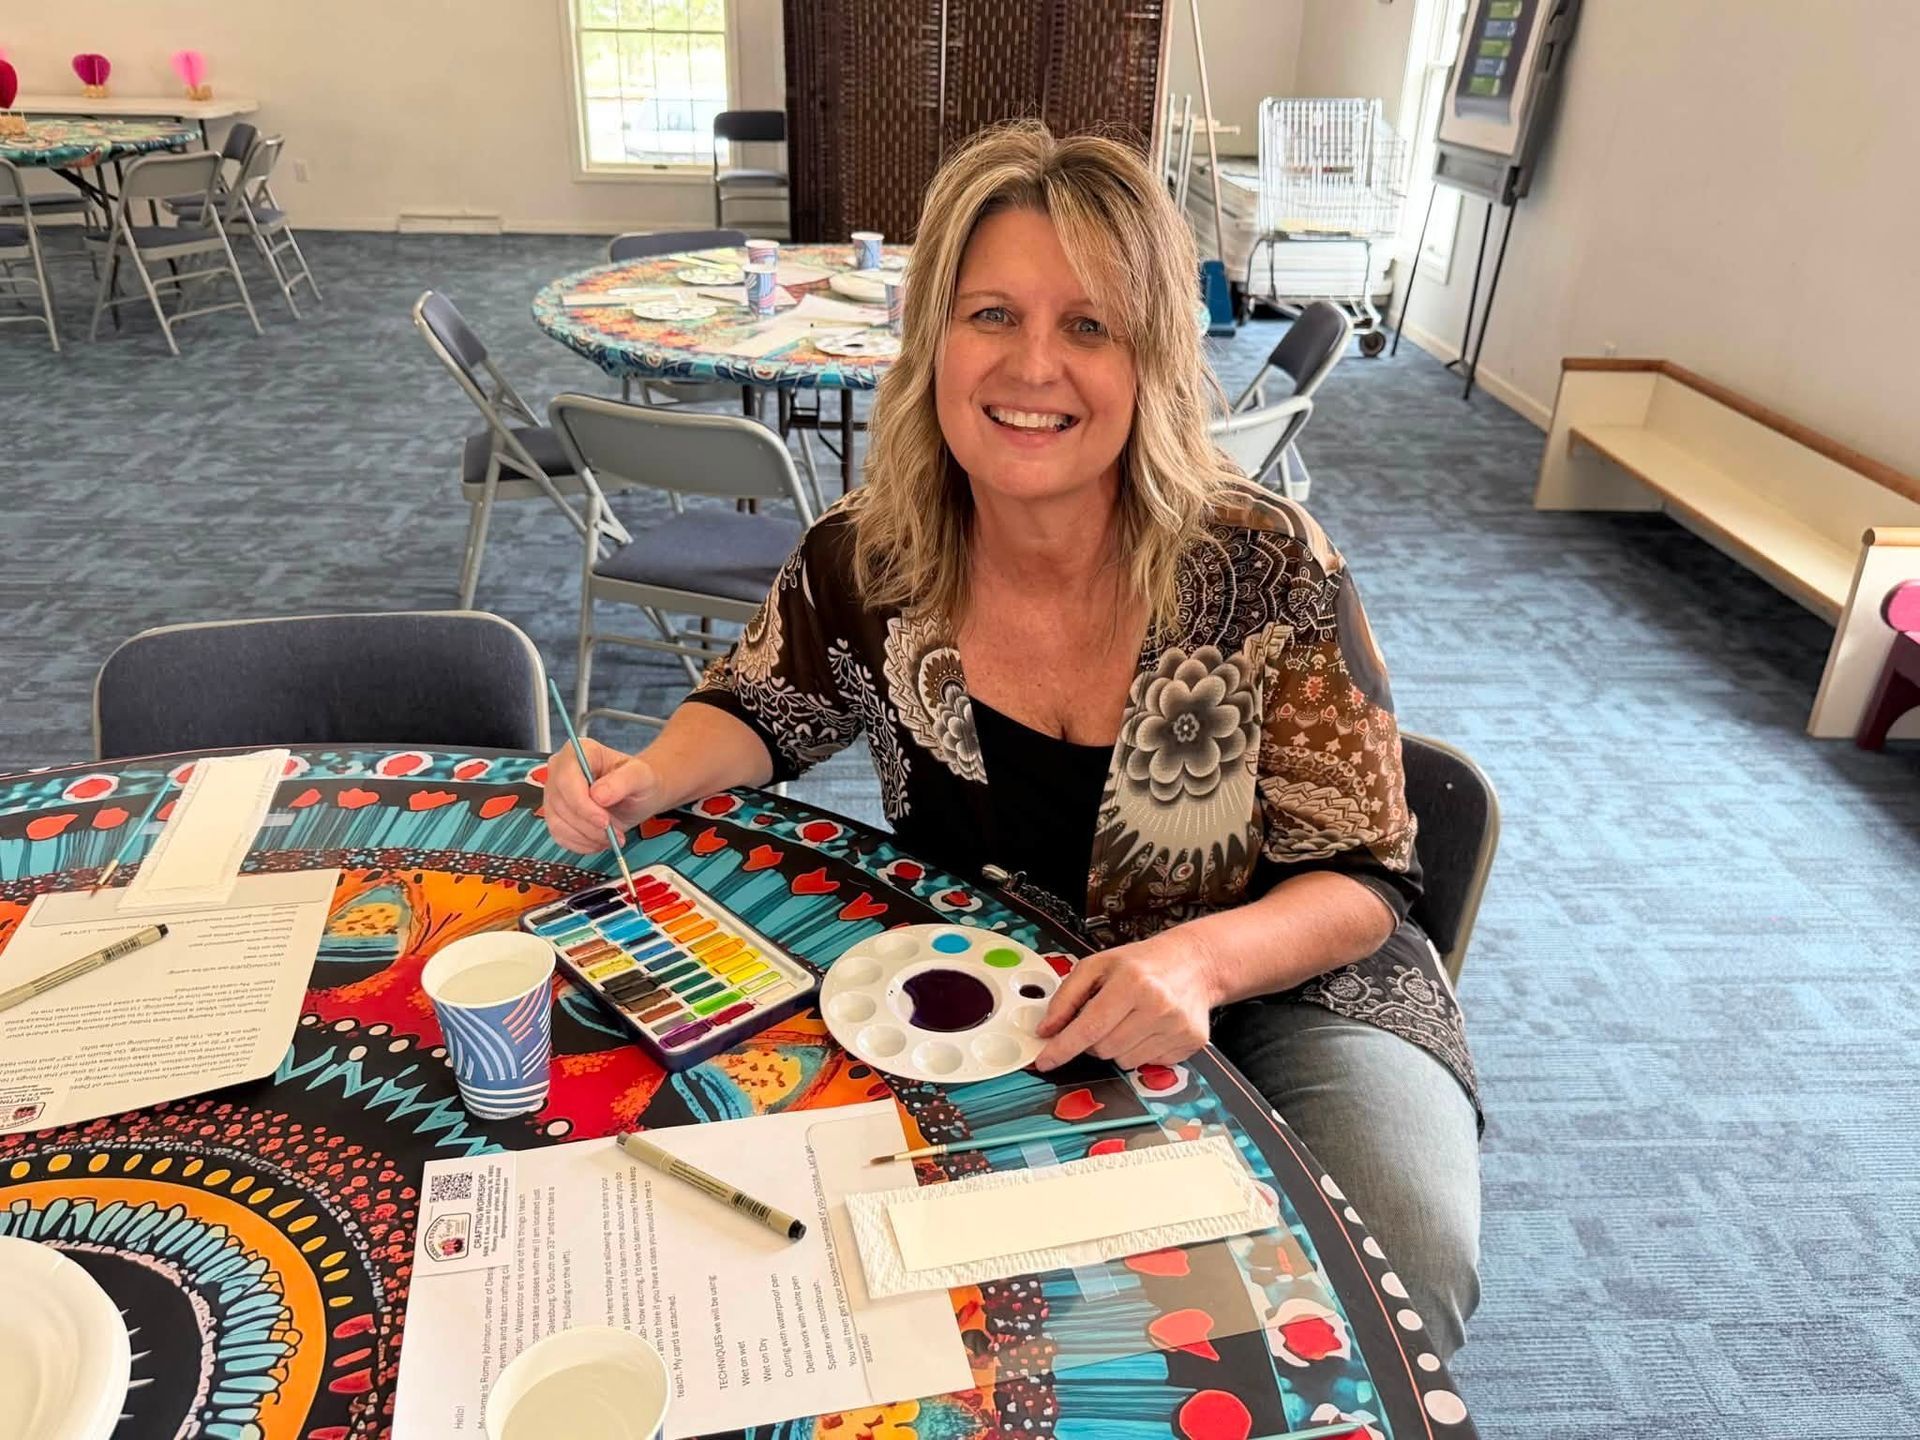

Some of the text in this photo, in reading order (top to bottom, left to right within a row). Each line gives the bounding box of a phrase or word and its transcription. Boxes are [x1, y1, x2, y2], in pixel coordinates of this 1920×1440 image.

[601, 1176, 609, 1191] your
[615, 1171, 621, 1180] do
[644, 1179, 650, 1187] to
[601, 1191, 609, 1210] share
[629, 1181, 637, 1203] Please
[645, 1187, 651, 1198] me
[472, 1173, 487, 1249] CRAFTING WORKSHOP
[645, 1199, 653, 1211] like
[816, 1197, 826, 1210] you
[532, 1201, 540, 1226] located
[602, 1210, 609, 1218] to
[646, 1212, 655, 1232] would
[517, 1215, 526, 1235] things
[603, 1219, 609, 1230] me
[631, 1224, 640, 1243] learn
[819, 1216, 833, 1250] laminated
[517, 1236, 525, 1248] the
[602, 1231, 612, 1261] allowing
[633, 1243, 640, 1251] to
[649, 1233, 657, 1245] you
[547, 1250, 554, 1260] on
[633, 1251, 641, 1266] love
[649, 1246, 657, 1265] class
[517, 1257, 525, 1272] one
[532, 1259, 540, 1275] with
[546, 1261, 555, 1282] South
[562, 1265, 570, 1278] the
[604, 1261, 612, 1275] and
[825, 1250, 841, 1287] bookmark
[546, 1283, 555, 1294] Go
[563, 1278, 570, 1289] on
[604, 1276, 614, 1296] today
[651, 1271, 659, 1289] have
[770, 1272, 779, 1287] pen
[484, 1286, 493, 1295] of
[532, 1276, 540, 1304] classes
[652, 1289, 662, 1303] you
[834, 1286, 846, 1304] your
[484, 1295, 493, 1319] owner
[562, 1288, 572, 1319] building
[621, 1291, 631, 1324] pleasure
[709, 1296, 718, 1306] be
[771, 1288, 787, 1329] waterproof
[499, 1303, 508, 1325] teach
[514, 1291, 525, 1333] Watercolor
[531, 1304, 539, 1321] take
[653, 1310, 662, 1326] hire
[710, 1306, 720, 1321] will
[837, 1304, 848, 1317] get
[654, 1326, 663, 1337] for
[713, 1321, 722, 1333] we
[791, 1275, 816, 1373] Detail work with white pen
[820, 1322, 831, 1340] with
[839, 1317, 851, 1335] then
[481, 1319, 493, 1354] Johnson,
[499, 1326, 507, 1341] and
[778, 1329, 789, 1347] with
[655, 1338, 664, 1352] am
[671, 1338, 680, 1357] card
[843, 1336, 854, 1350] will
[859, 1332, 873, 1363] started!
[498, 1342, 507, 1368] events
[672, 1357, 684, 1370] My
[713, 1333, 730, 1390] TECHNIQUES
[736, 1340, 751, 1386] Wet on wet
[757, 1336, 772, 1381] Wet on Dry
[823, 1340, 838, 1370] Spatter
[846, 1350, 858, 1366] You
[479, 1355, 491, 1383] Romey
[674, 1371, 685, 1398] teach.
[453, 1404, 465, 1430] Hello!
